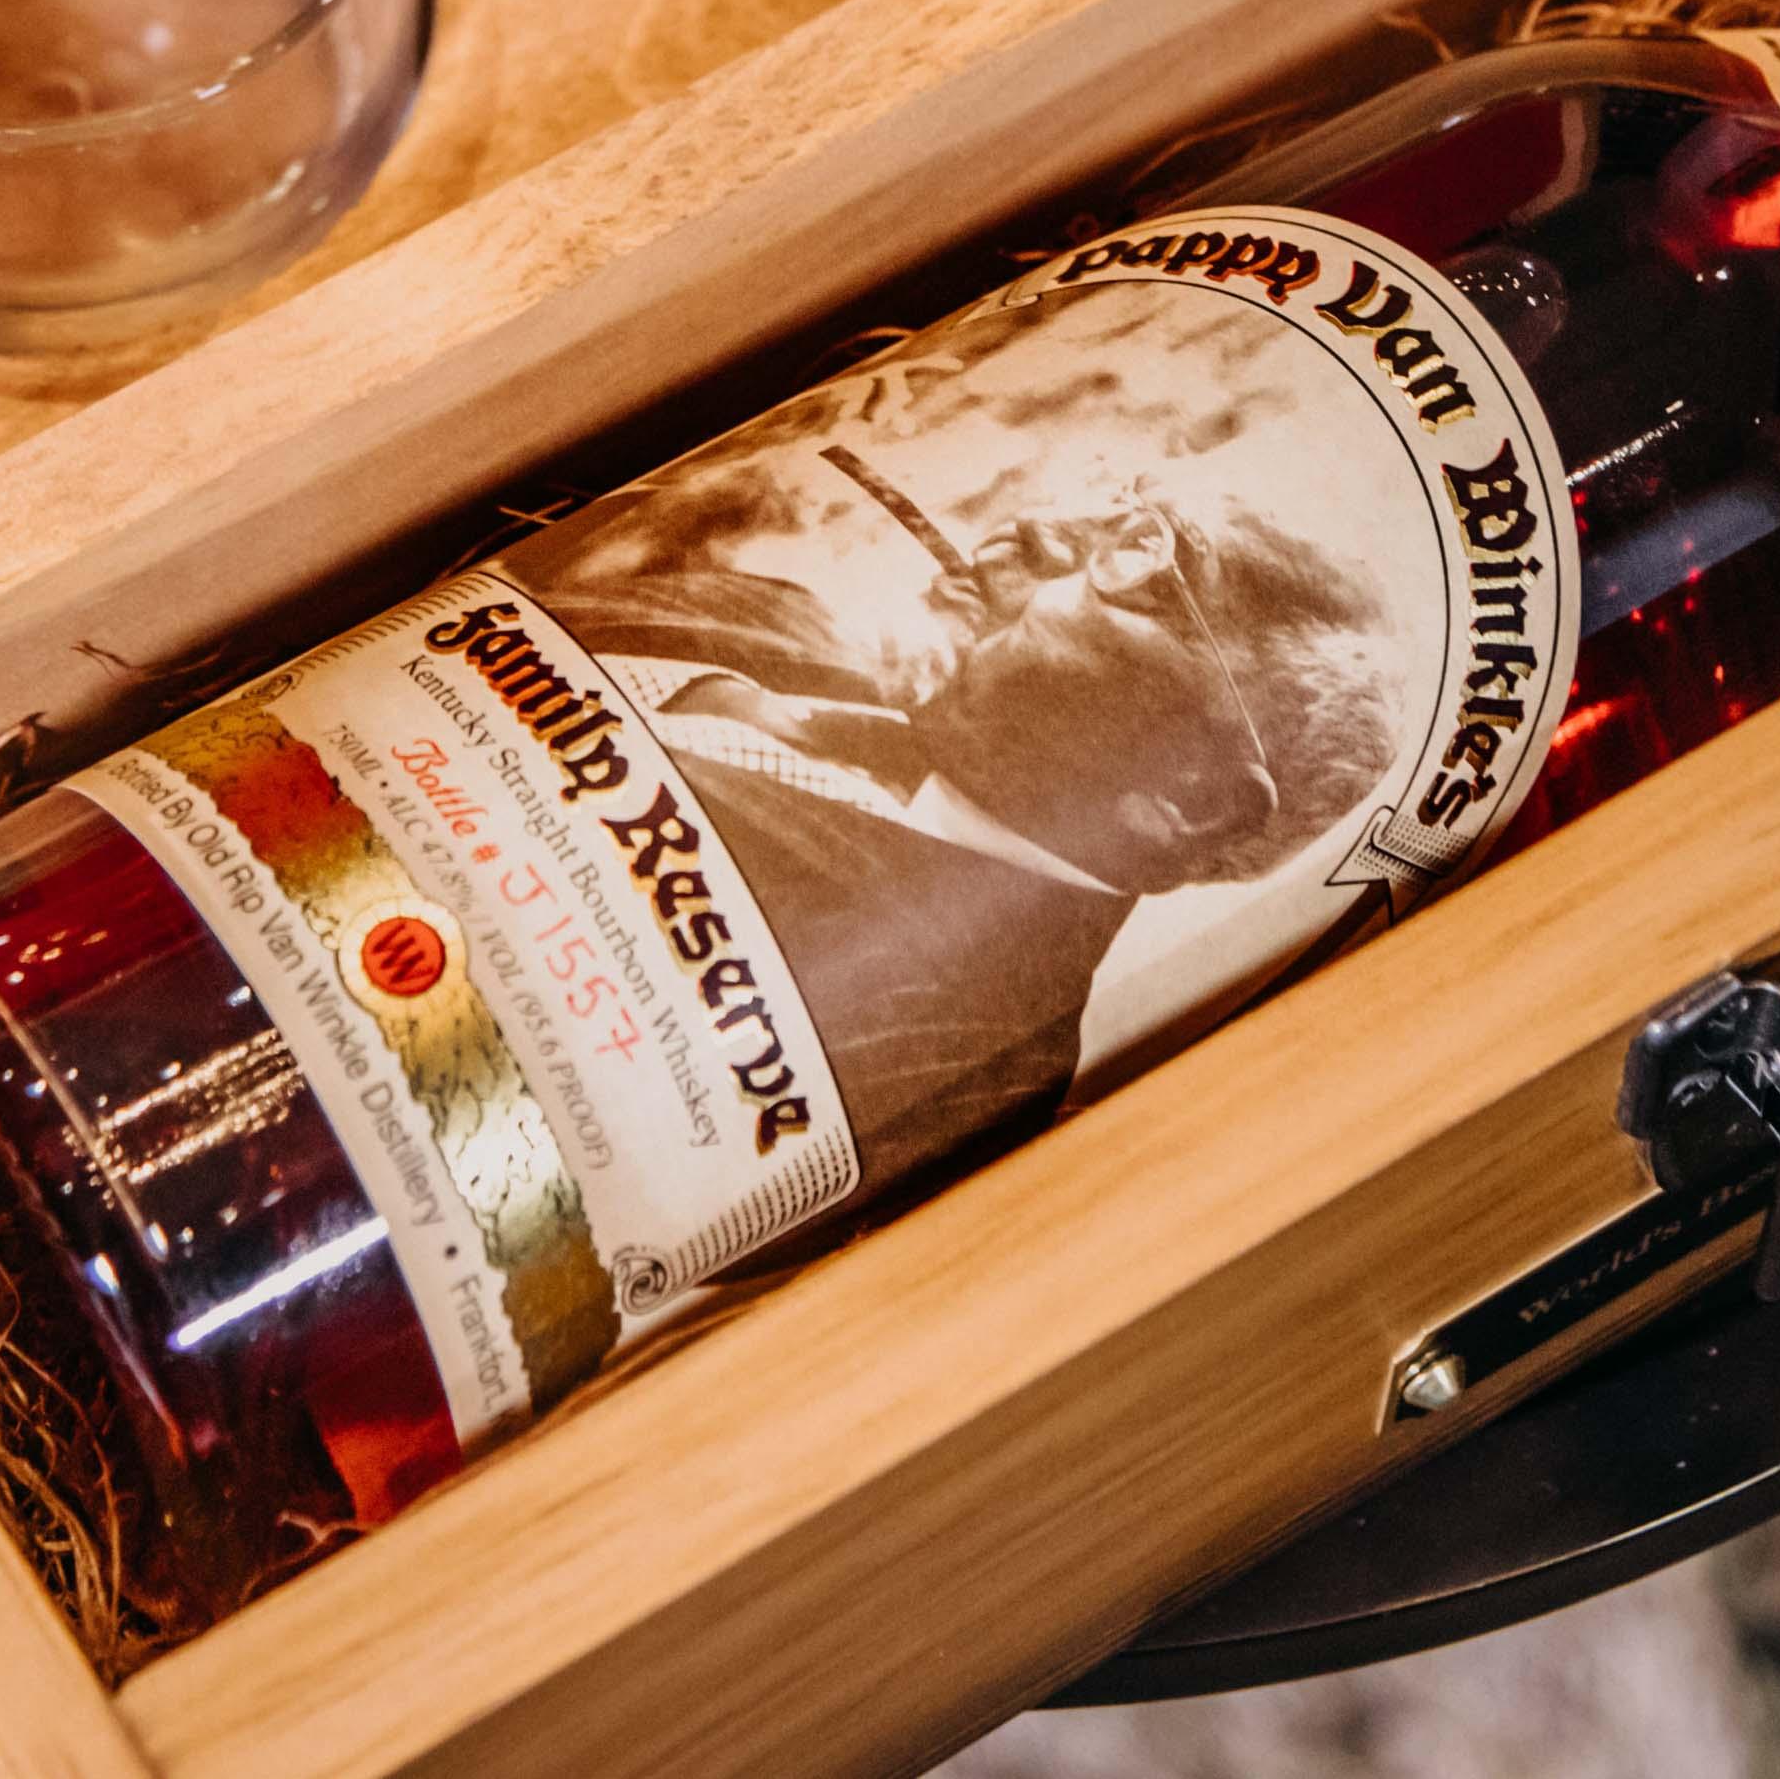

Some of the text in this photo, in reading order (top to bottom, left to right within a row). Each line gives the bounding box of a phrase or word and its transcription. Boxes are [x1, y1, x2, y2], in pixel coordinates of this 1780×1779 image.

[1055, 230, 1545, 831] Pappy Van Winkle's
[381, 794, 433, 837] ALC
[480, 928, 524, 989] VOL
[390, 736, 490, 838] Bottle
[399, 654, 720, 1149] Kentucky Straight Bourbon Whiskey
[424, 600, 812, 1158] Family Reserve
[159, 796, 194, 830] By
[186, 823, 239, 868] Old
[220, 863, 265, 914] Rip
[258, 908, 304, 973] Van
[297, 969, 369, 1081] Winkle
[360, 1081, 447, 1227] Distillery
[1518, 1219, 1683, 1323] World's
